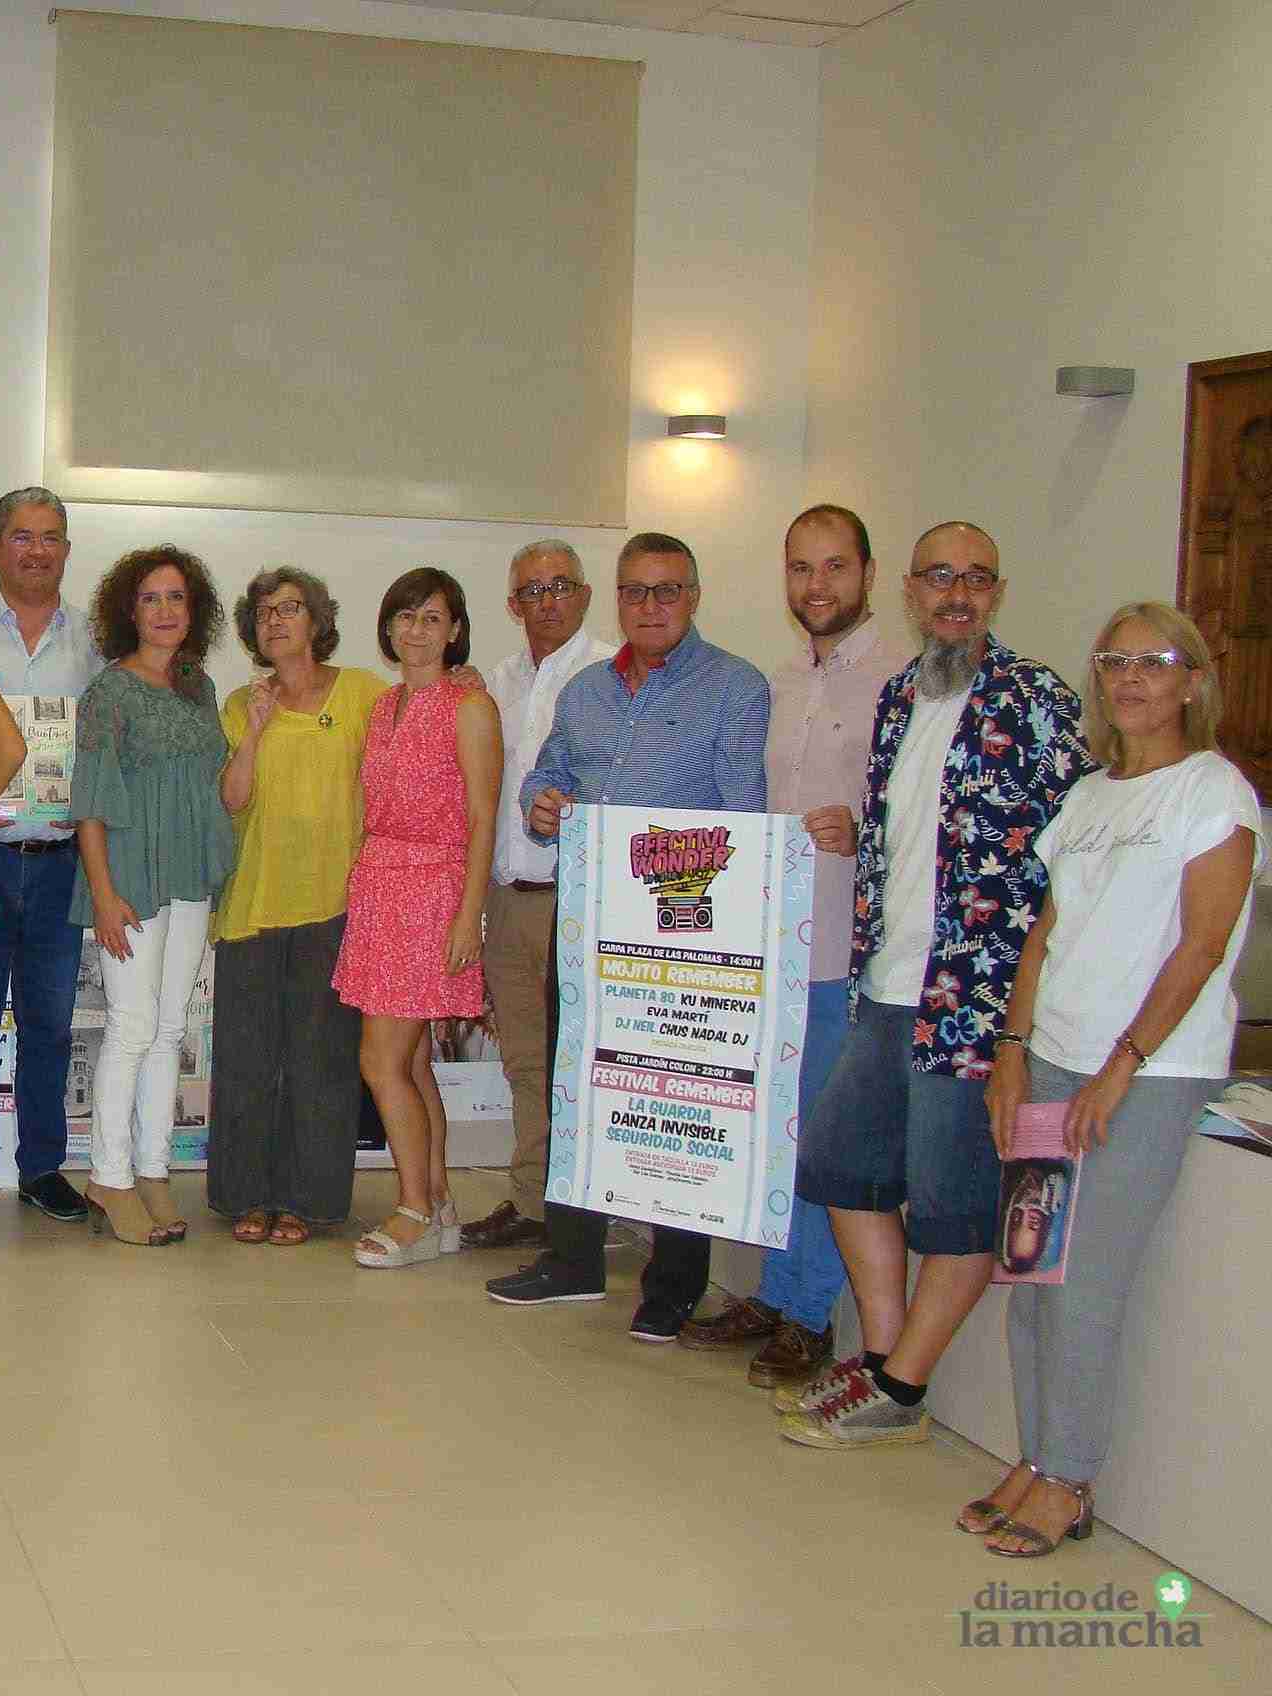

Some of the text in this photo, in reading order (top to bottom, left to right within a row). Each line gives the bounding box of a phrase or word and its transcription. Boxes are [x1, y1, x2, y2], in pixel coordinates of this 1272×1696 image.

[631, 846, 729, 878] WONDER
[600, 943, 626, 954] CARPA
[627, 945, 652, 957] PLAZA
[654, 948, 664, 958] DE
[666, 950, 681, 960] LAS
[682, 951, 723, 964] PALOMAS
[754, 958, 761, 968] H
[602, 960, 757, 992] MOJITO REMEMBER
[605, 984, 657, 1002] PLANETA
[680, 993, 697, 1007] KU
[699, 995, 756, 1014] MINERVA
[647, 1006, 711, 1024] EVA MARTÍ
[615, 1017, 750, 1047] DJ NEIL CHUS NADAL DJ
[616, 1053, 639, 1065] PISTA
[592, 1067, 754, 1107] FESTIVAL REMEMBER
[627, 1096, 712, 1124] LA GUARDIA
[611, 1110, 728, 1144] DANZA INVISIBLE
[605, 1126, 736, 1162] SEGURIDAD SOCIAL
